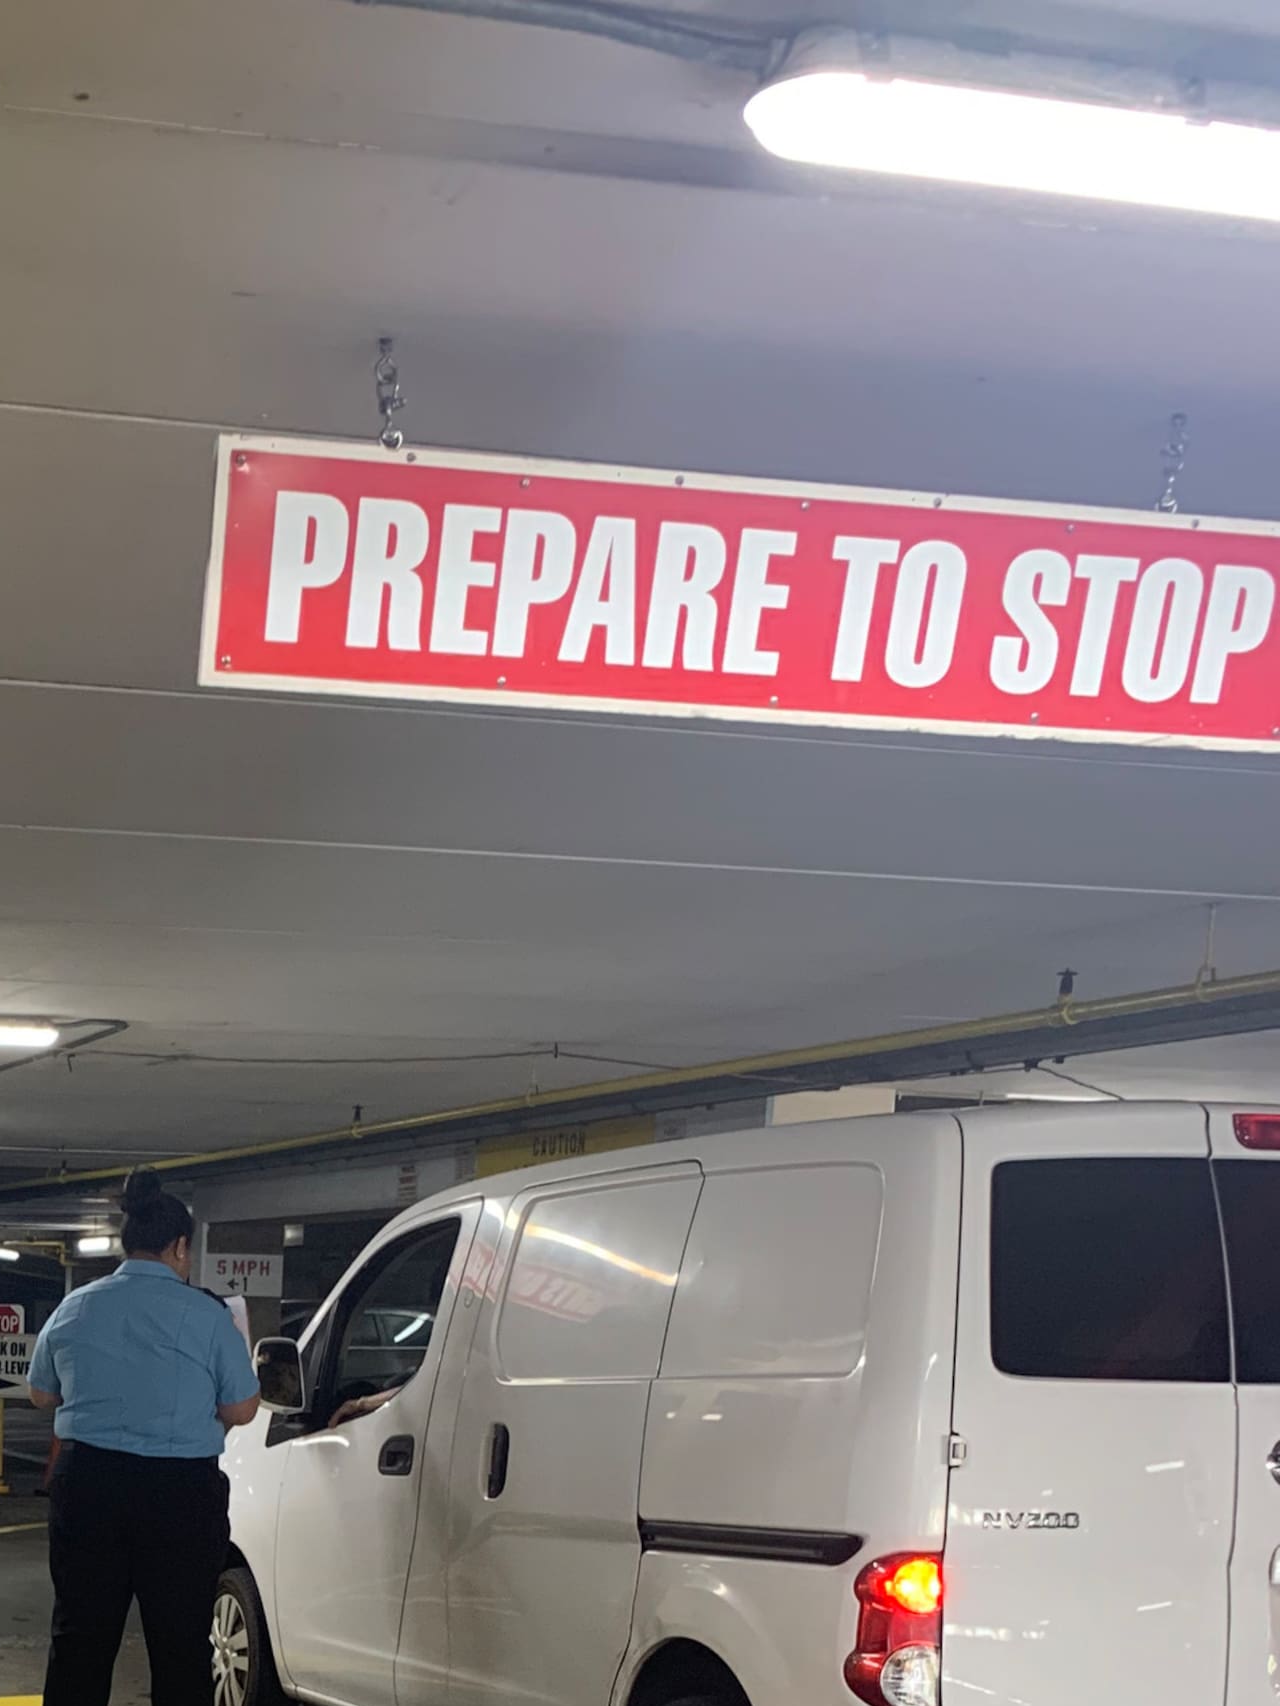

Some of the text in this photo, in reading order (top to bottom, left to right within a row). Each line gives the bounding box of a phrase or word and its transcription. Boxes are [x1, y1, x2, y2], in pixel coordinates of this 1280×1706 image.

[264, 491, 1275, 705] PREPARE TO STOP
[532, 1132, 586, 1157] CAUTION
[216, 1260, 270, 1276] 5 MPH
[10, 1343, 26, 1357] ON
[5, 1361, 31, 1375] LEVE
[983, 1512, 1080, 1529] NV200
